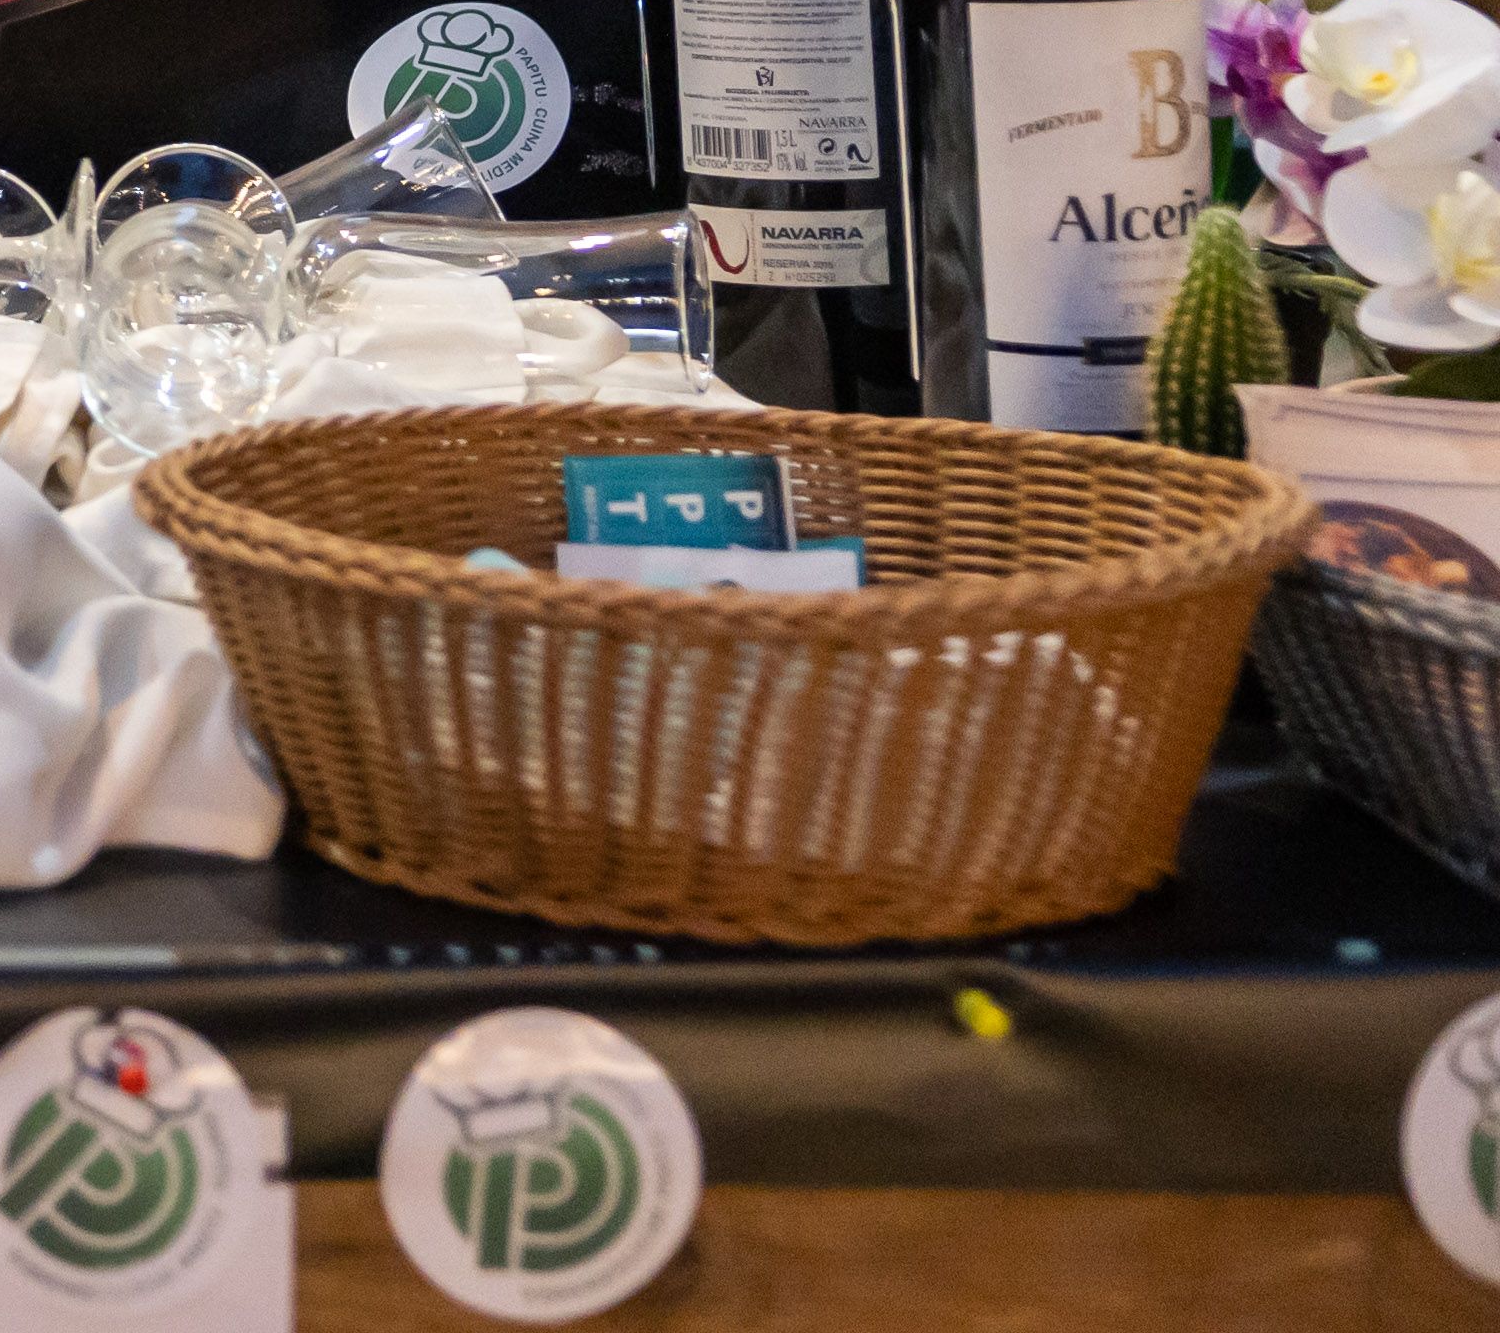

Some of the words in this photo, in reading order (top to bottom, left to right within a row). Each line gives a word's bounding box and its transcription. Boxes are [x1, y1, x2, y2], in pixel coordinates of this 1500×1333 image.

[515, 47, 547, 97] PAPITU
[1128, 49, 1192, 159] B
[520, 108, 547, 152] CUINA
[799, 116, 867, 129] NAVARRA
[761, 227, 863, 240] NAVARRA
[763, 258, 810, 269] RESERVA
